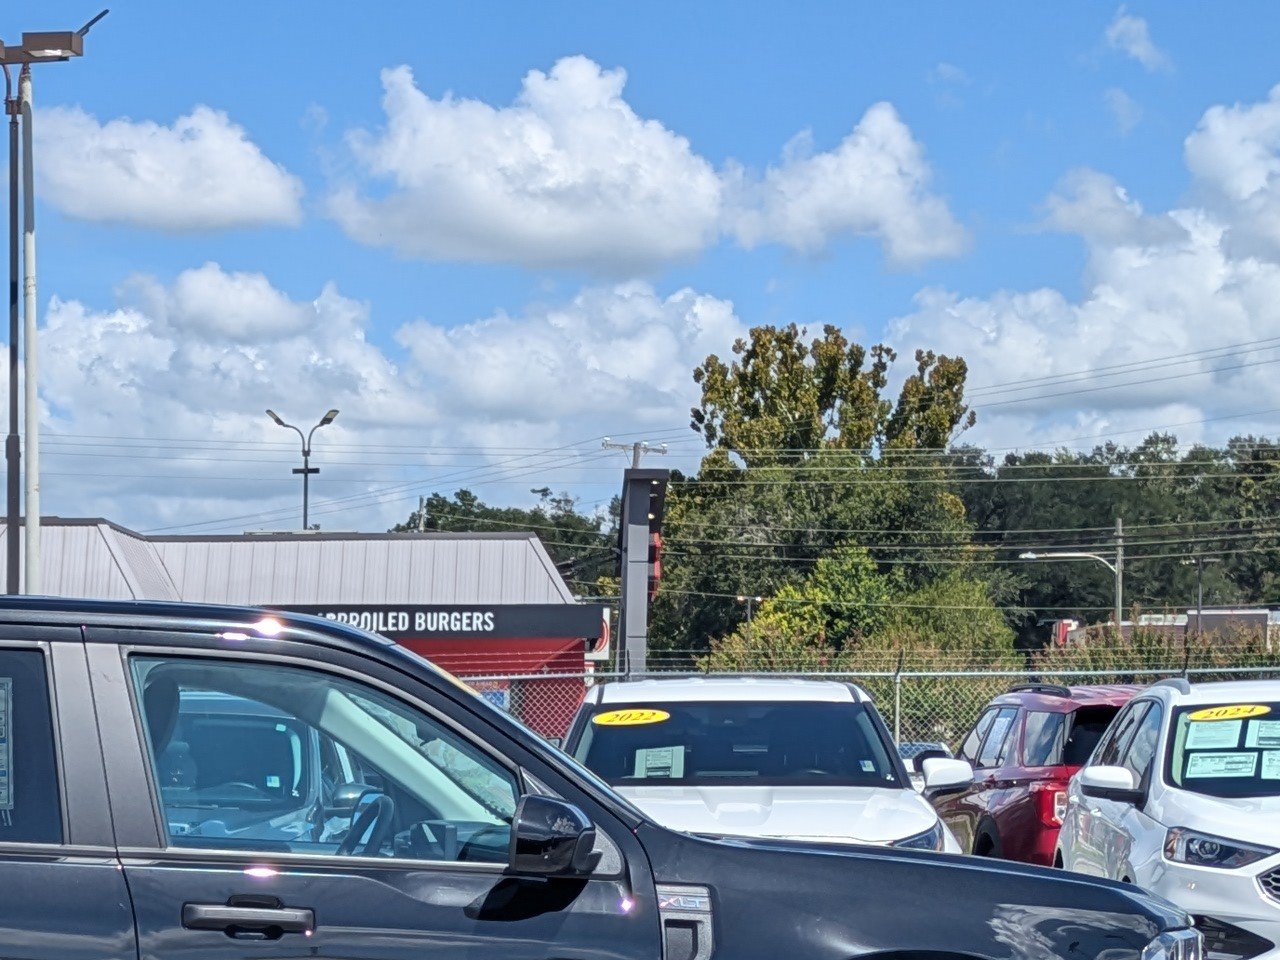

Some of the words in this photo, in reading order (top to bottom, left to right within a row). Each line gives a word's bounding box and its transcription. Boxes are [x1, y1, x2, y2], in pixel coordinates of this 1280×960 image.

[414, 611, 495, 632] BURGERS
[605, 710, 657, 723] 2022
[1200, 706, 1257, 719] 2024
[659, 894, 709, 908] XLT
